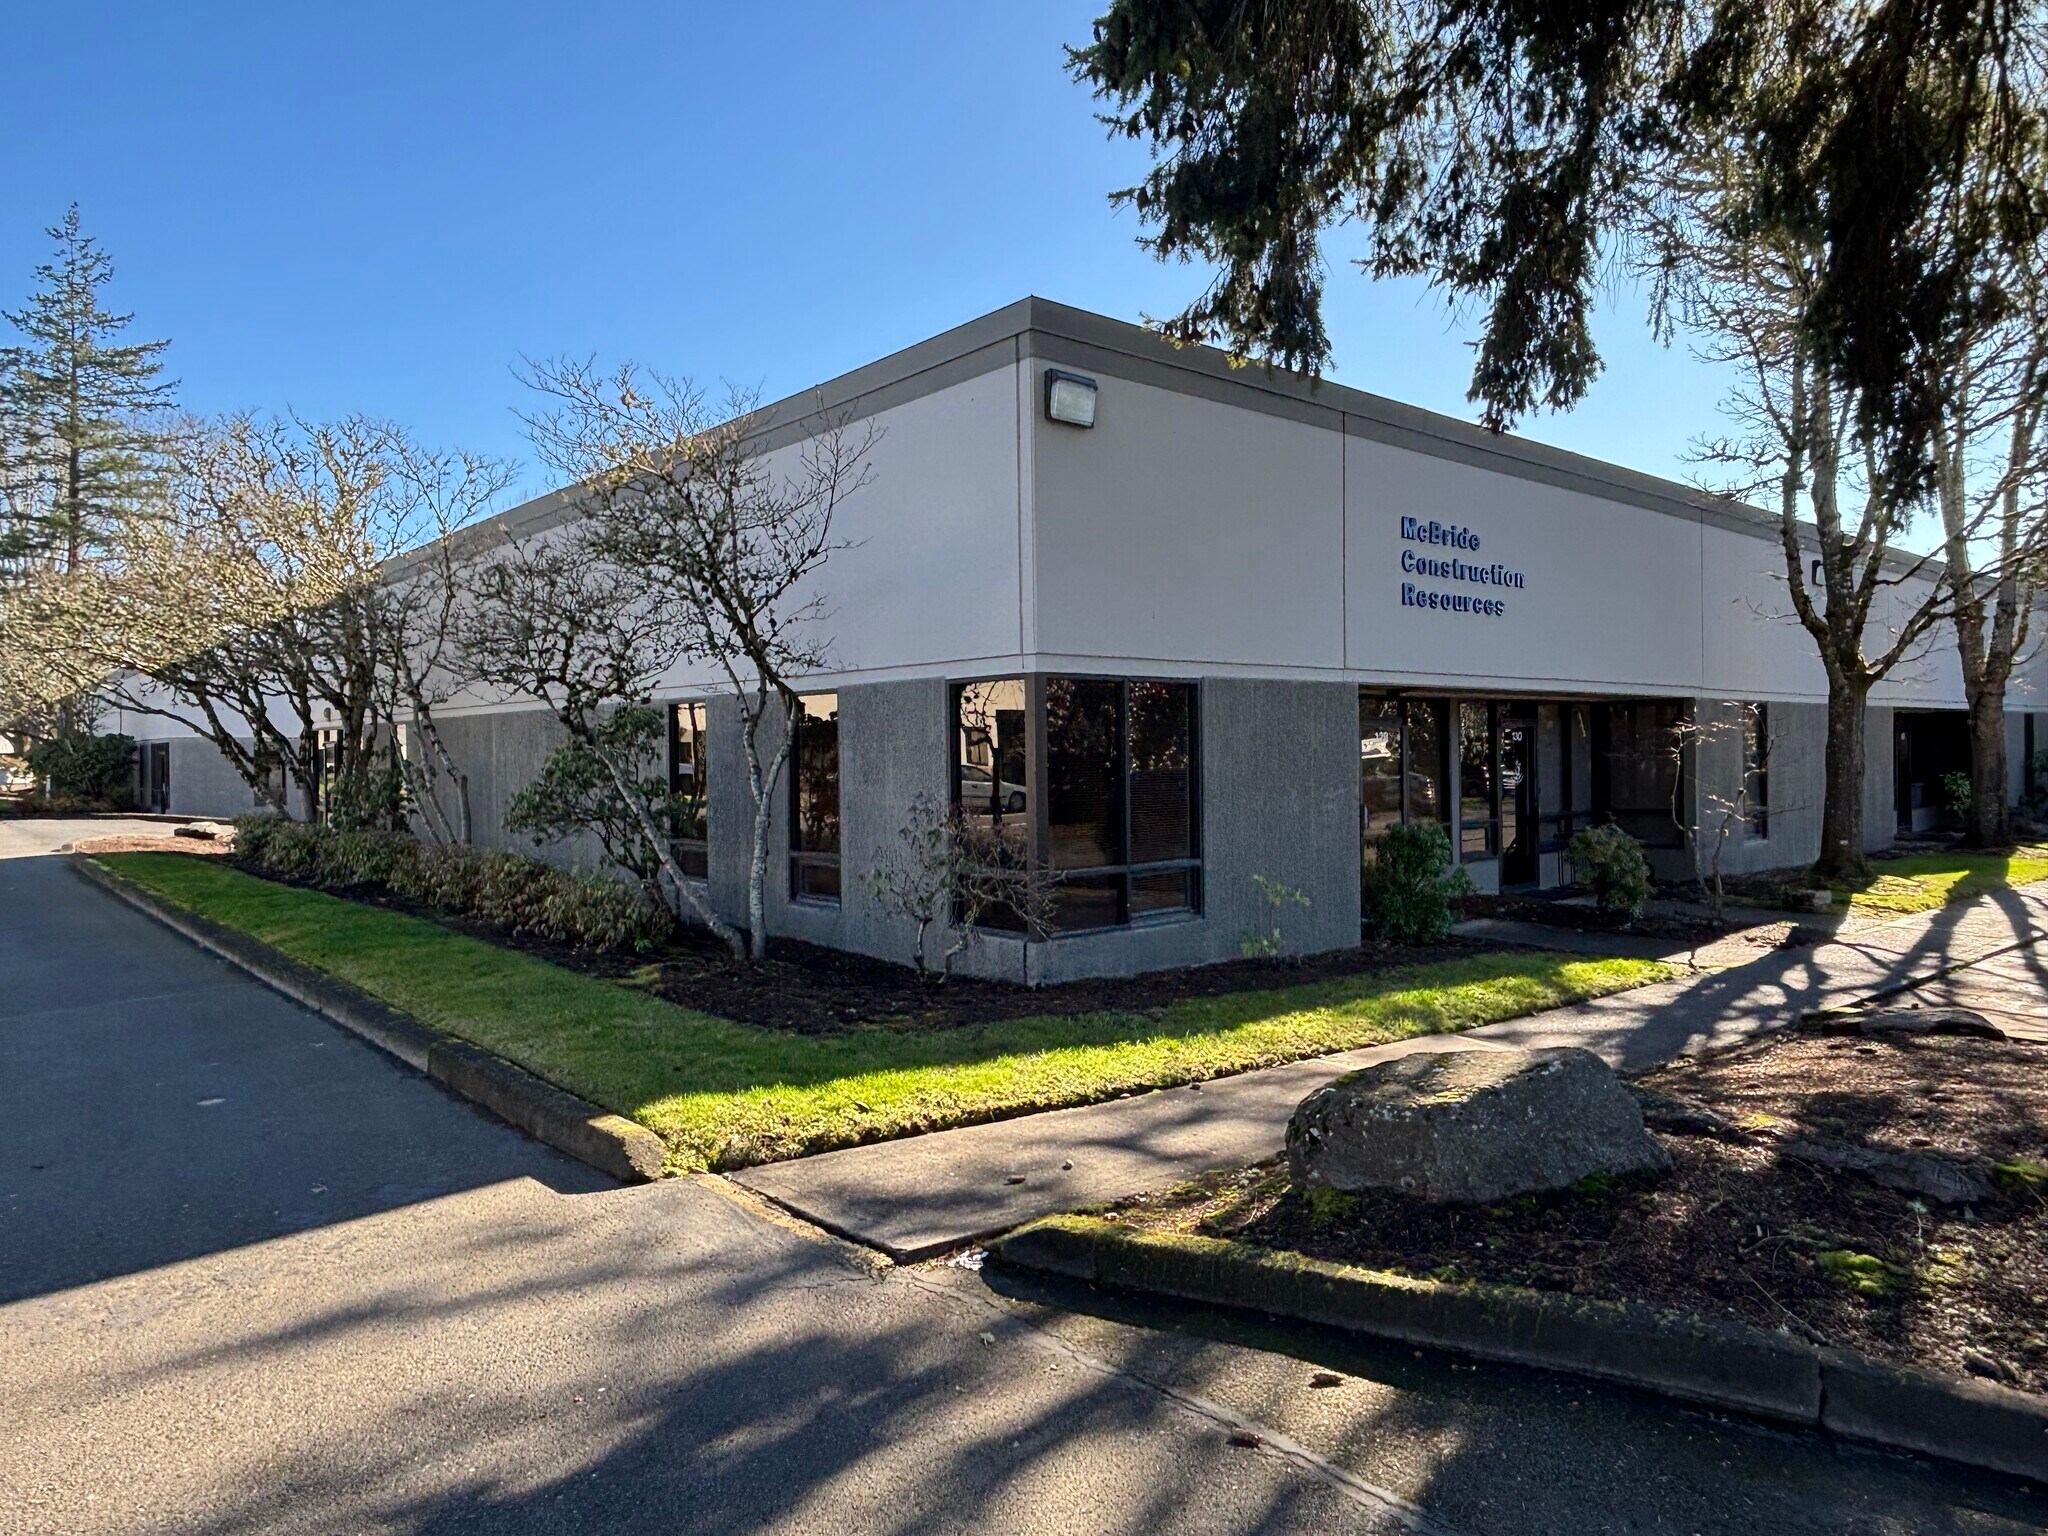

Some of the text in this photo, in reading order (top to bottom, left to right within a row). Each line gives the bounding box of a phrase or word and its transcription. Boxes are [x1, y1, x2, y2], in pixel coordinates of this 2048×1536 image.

[1401, 516, 1480, 551] McBride
[1401, 550, 1525, 588] Construction
[1402, 583, 1505, 616] Resources
